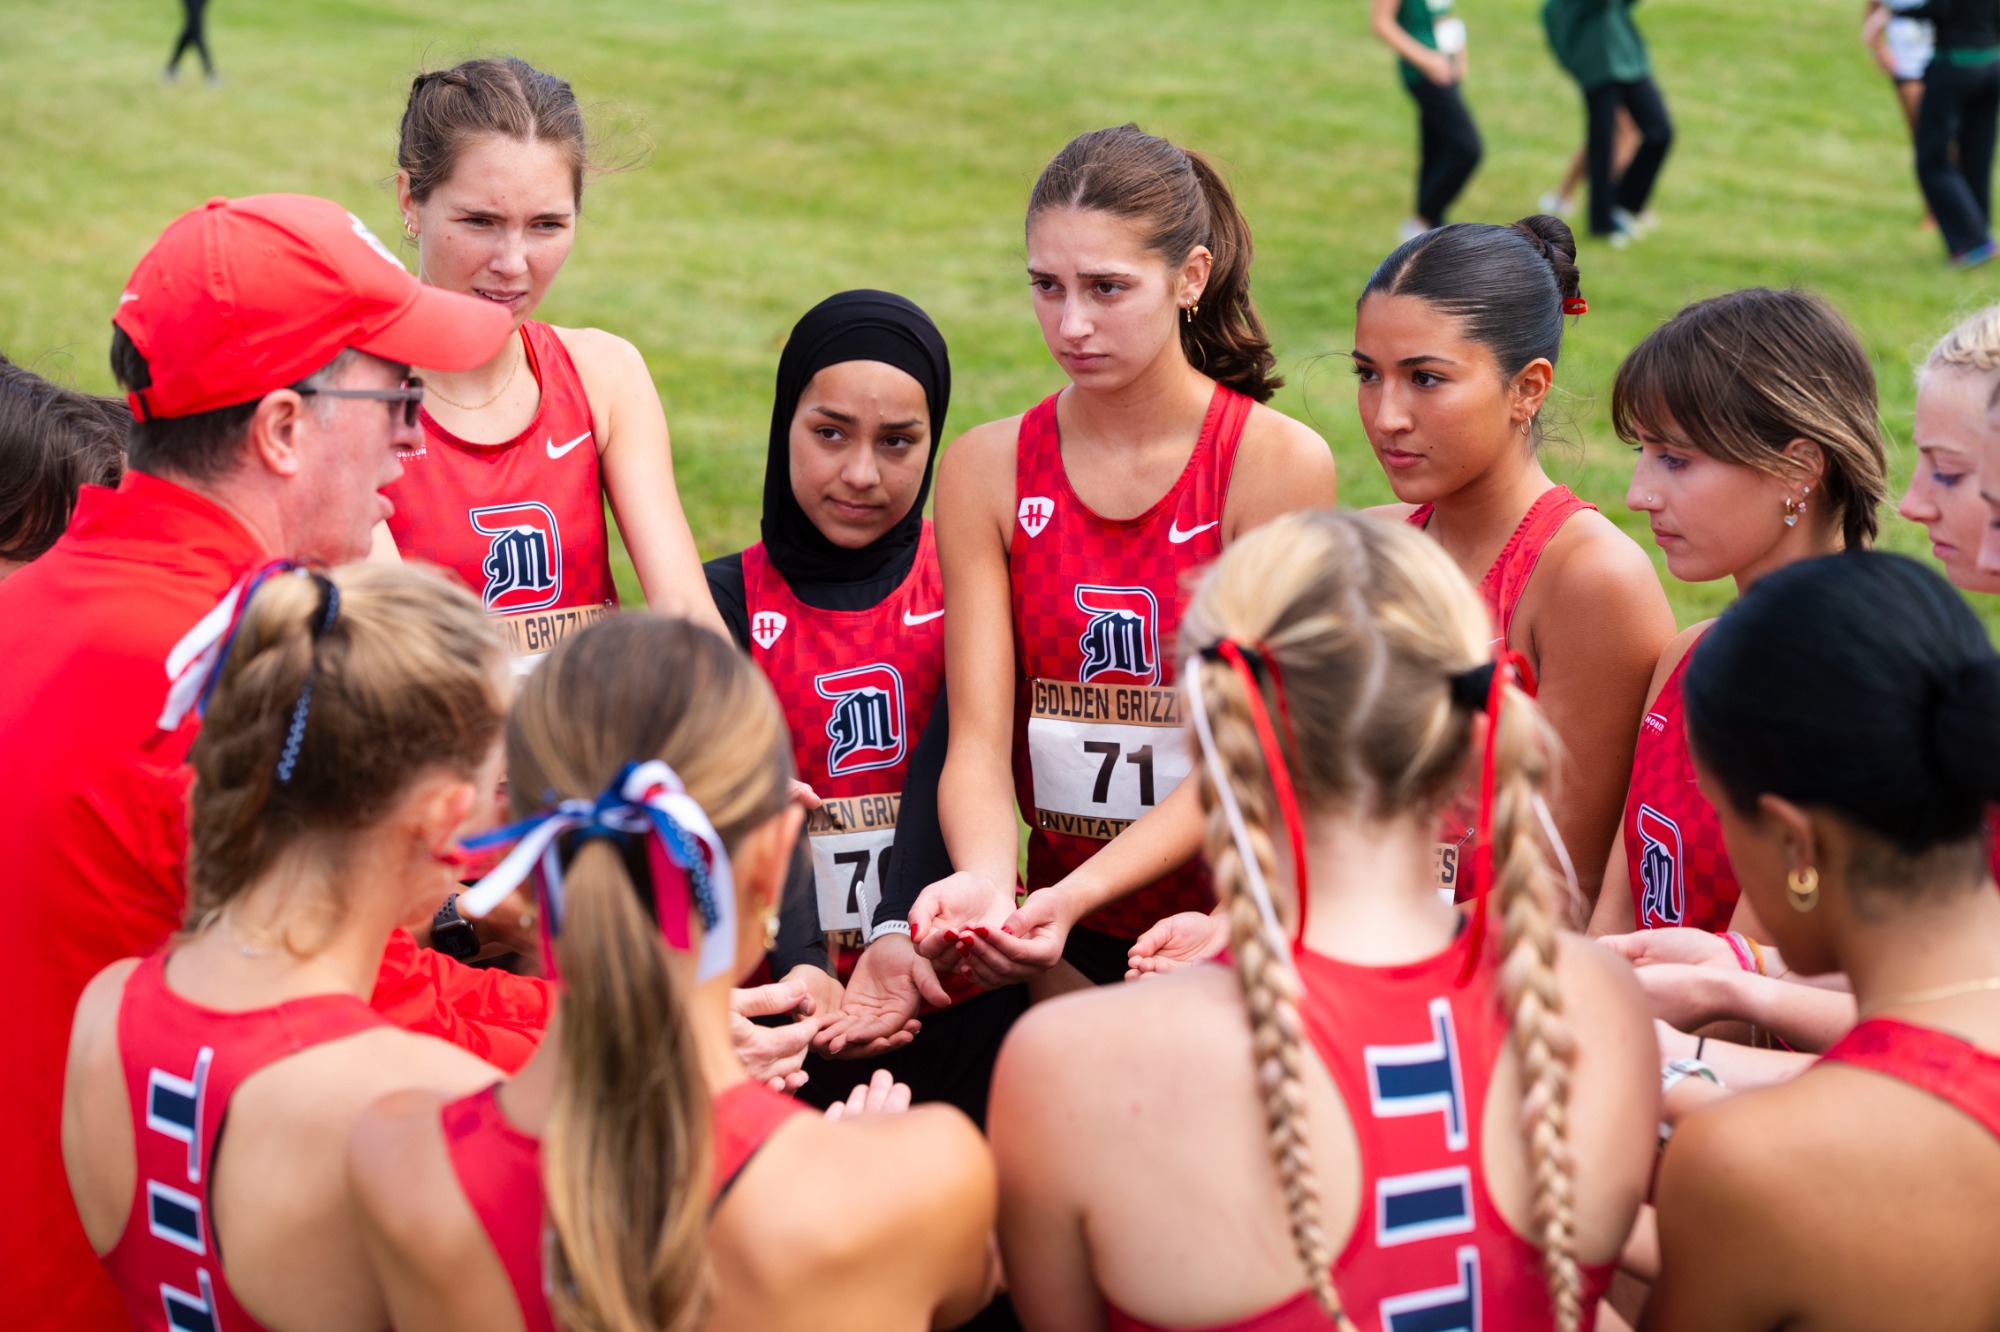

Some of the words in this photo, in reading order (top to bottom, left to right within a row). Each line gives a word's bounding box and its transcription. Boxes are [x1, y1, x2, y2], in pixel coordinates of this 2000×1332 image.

[1035, 682, 1110, 719] GOLDEN
[1084, 741, 1155, 806] 71
[1039, 810, 1131, 838] INVITAT
